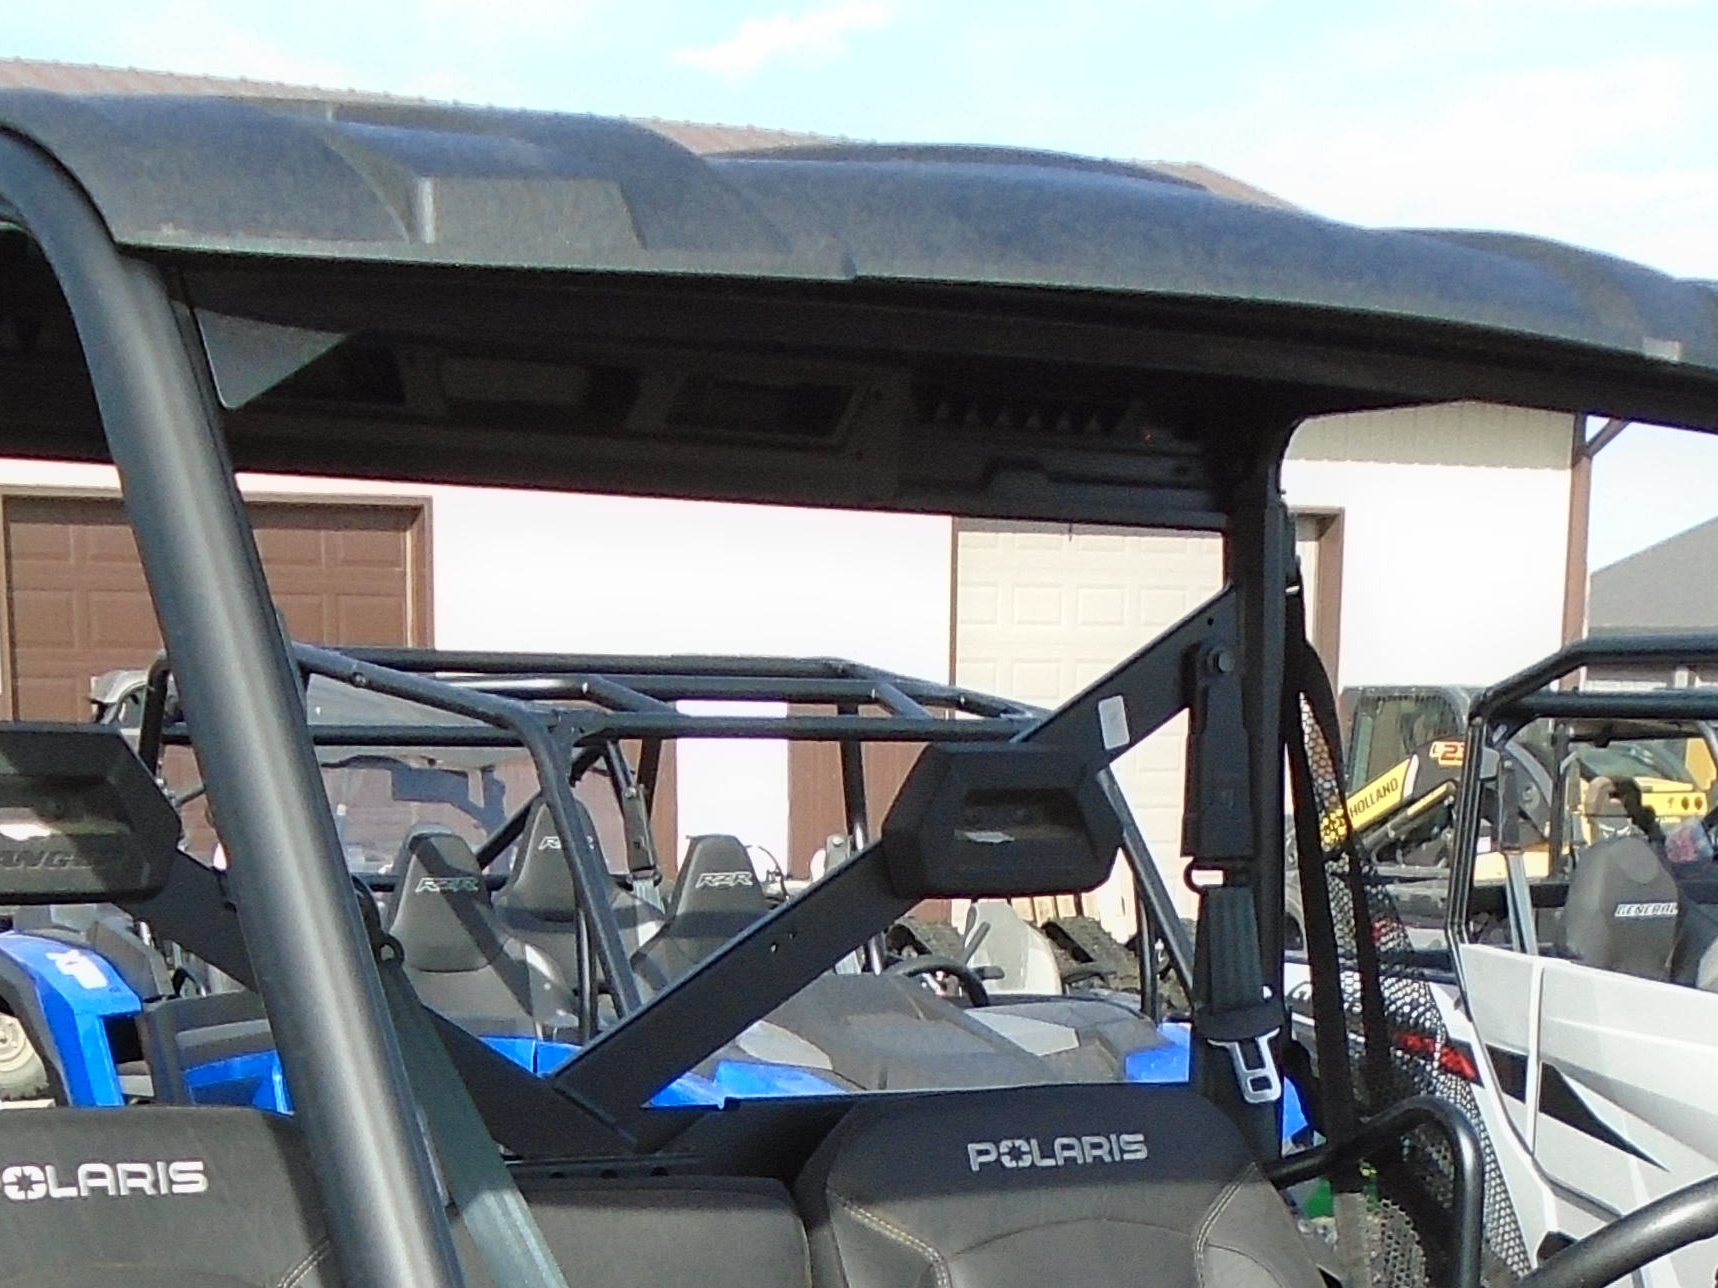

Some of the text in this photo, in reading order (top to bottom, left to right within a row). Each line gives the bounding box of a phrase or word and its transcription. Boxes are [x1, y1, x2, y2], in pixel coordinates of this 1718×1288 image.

[1349, 777, 1399, 819] HOLLAND
[1614, 902, 1678, 917] GENERAL
[967, 1132, 1149, 1173] POLARIS
